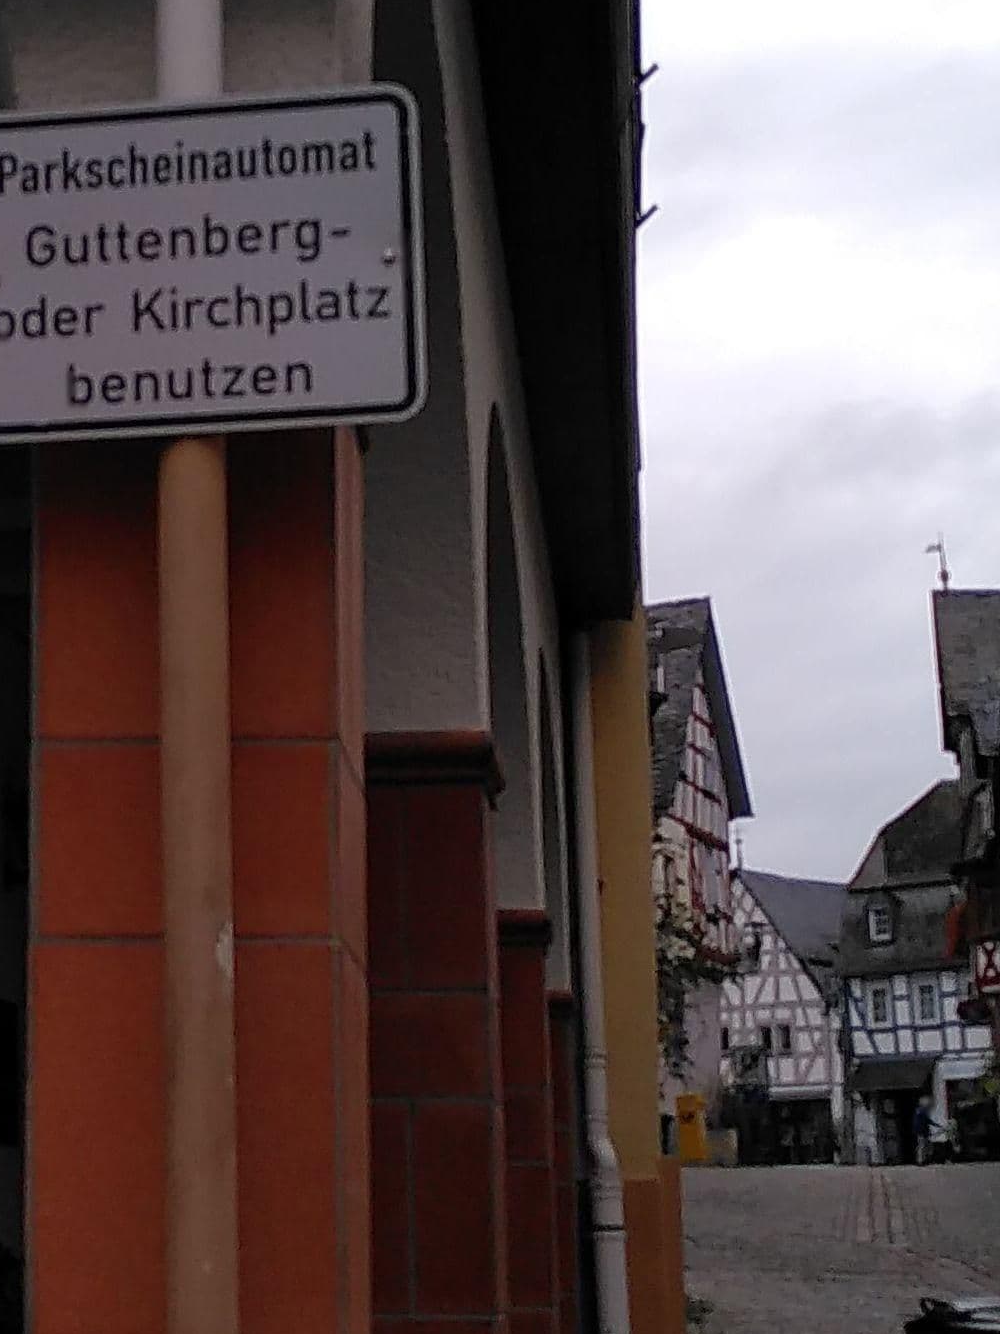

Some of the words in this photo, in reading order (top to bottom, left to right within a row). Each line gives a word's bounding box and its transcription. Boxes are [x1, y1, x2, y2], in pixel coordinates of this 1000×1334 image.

[26, 213, 351, 268] Guttenberg-
[132, 279, 392, 335] Kirchplatz
[68, 359, 313, 405] benutzen
